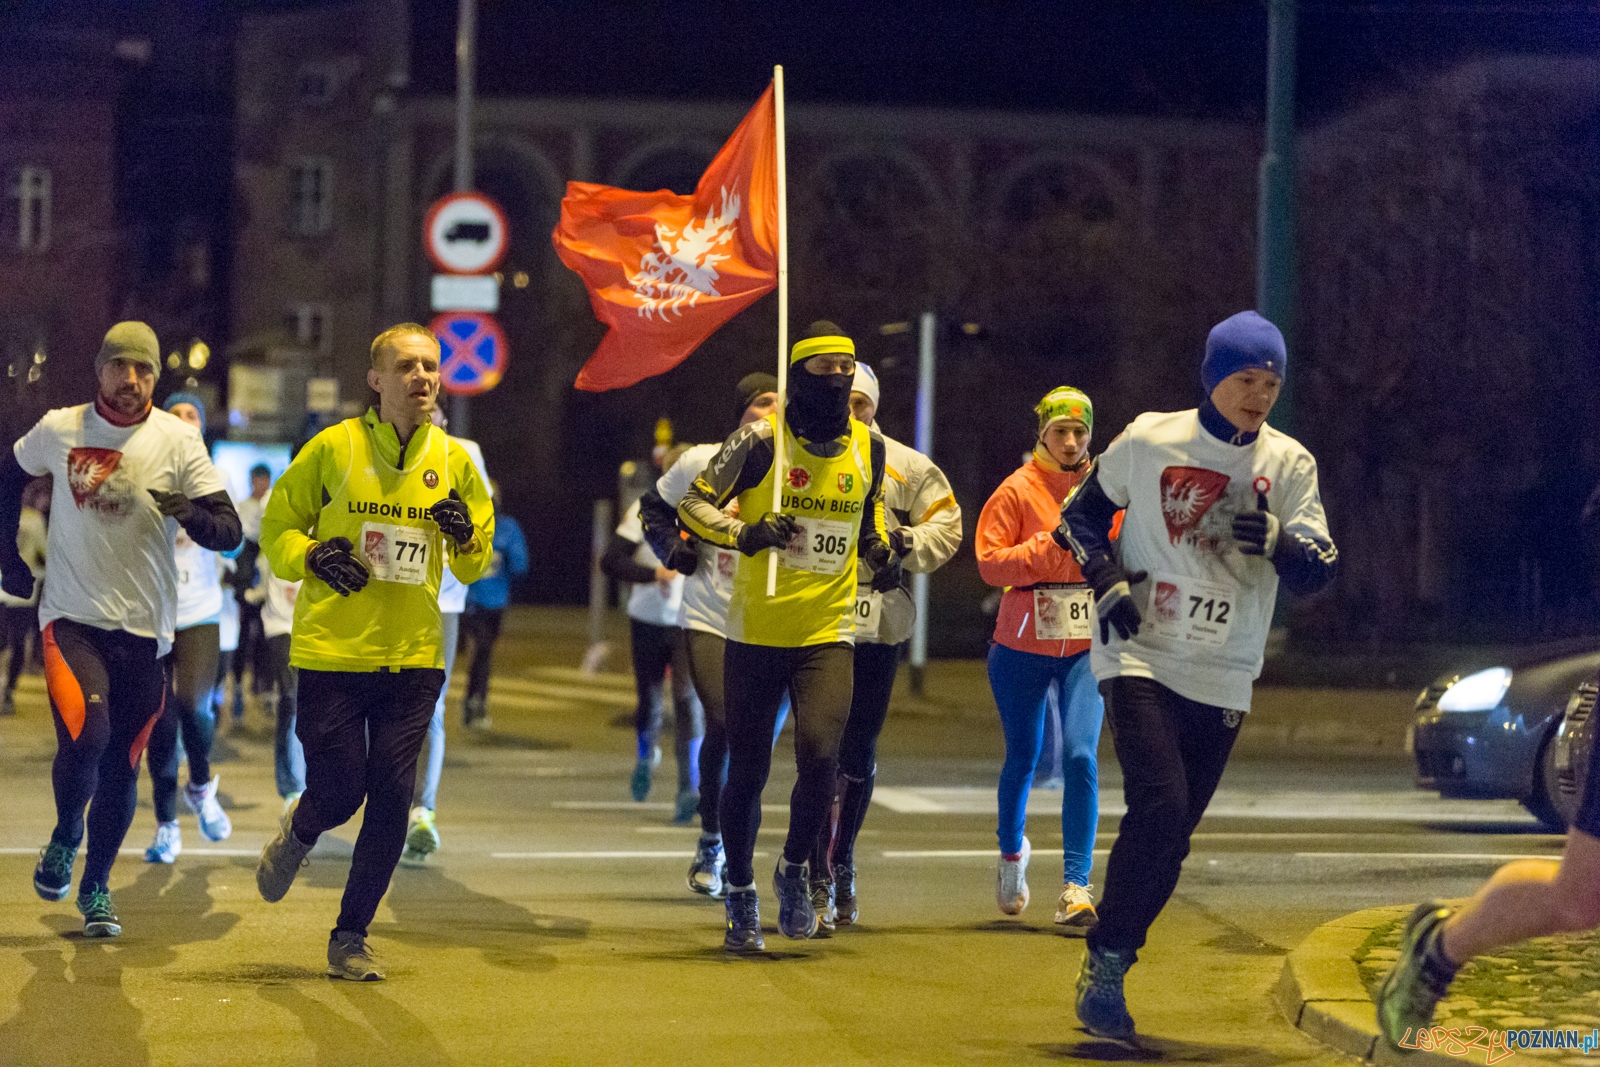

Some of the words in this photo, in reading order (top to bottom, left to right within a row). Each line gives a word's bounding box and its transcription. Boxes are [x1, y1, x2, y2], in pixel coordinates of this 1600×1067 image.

[348, 501, 402, 518] LUBOŃ
[407, 507, 432, 520] BIE
[780, 495, 825, 511] UBOŃ
[395, 540, 427, 564] 771
[813, 533, 847, 556] 305
[1070, 602, 1089, 620] 81
[1189, 595, 1230, 624] 712
